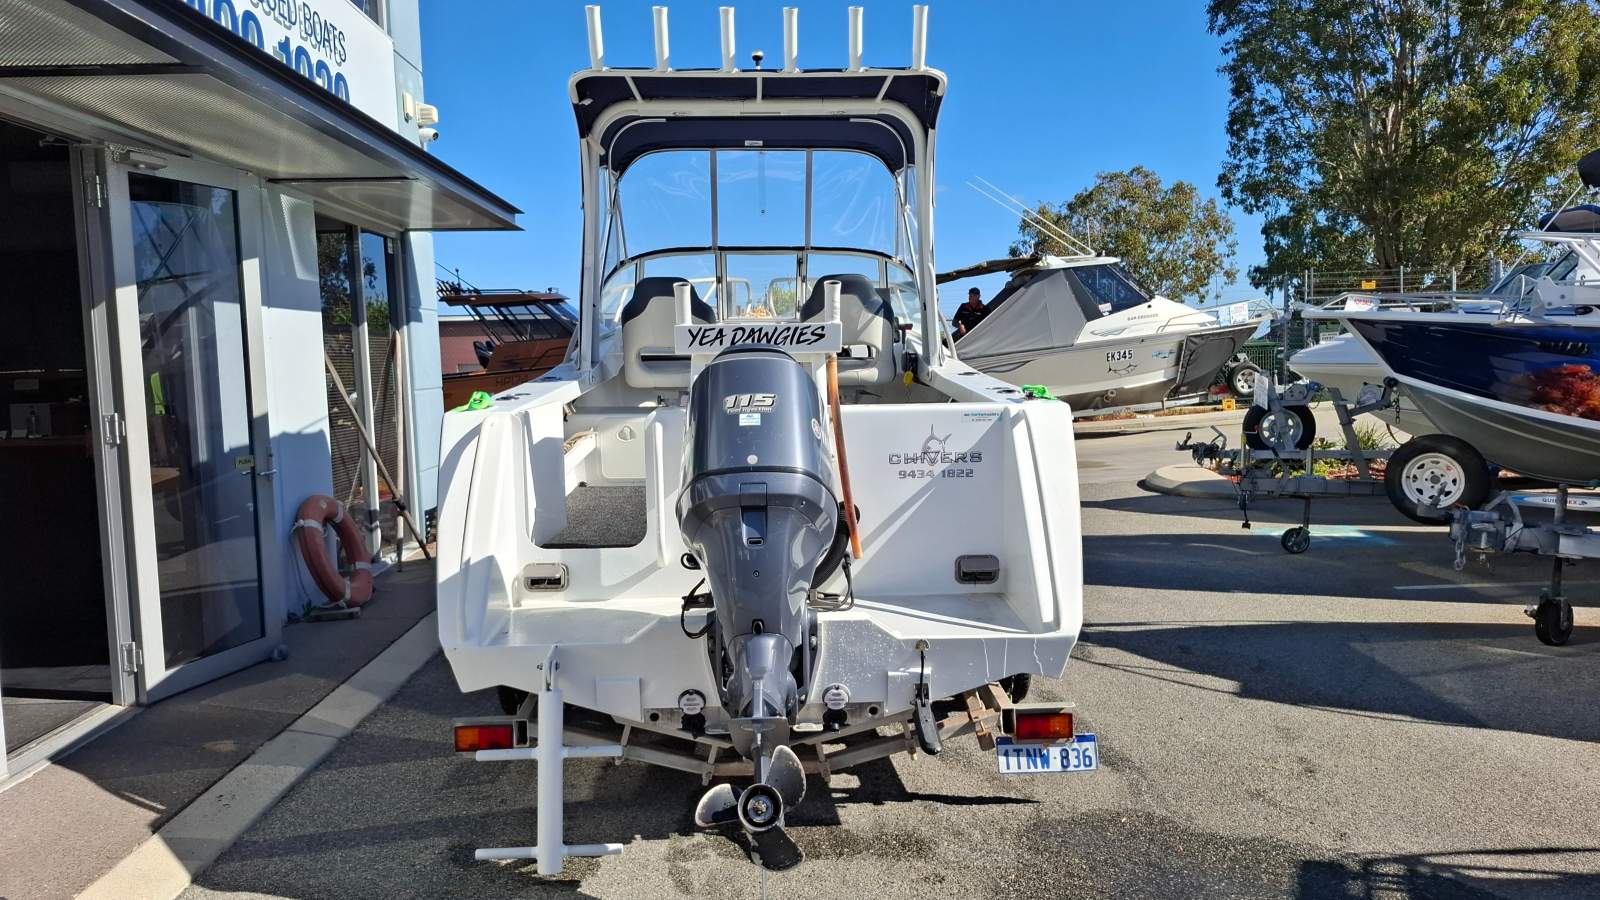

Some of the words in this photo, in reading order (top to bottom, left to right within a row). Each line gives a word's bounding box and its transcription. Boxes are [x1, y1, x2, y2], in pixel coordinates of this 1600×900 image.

[302, 1, 347, 63] BOATS
[687, 326, 727, 349] YEA
[730, 325, 826, 347] DAWGIES
[1106, 349, 1133, 362] EK345
[723, 393, 777, 409] 115
[888, 451, 983, 466] CHIVERS
[898, 469, 936, 479] 9434
[940, 468, 974, 478] 1822
